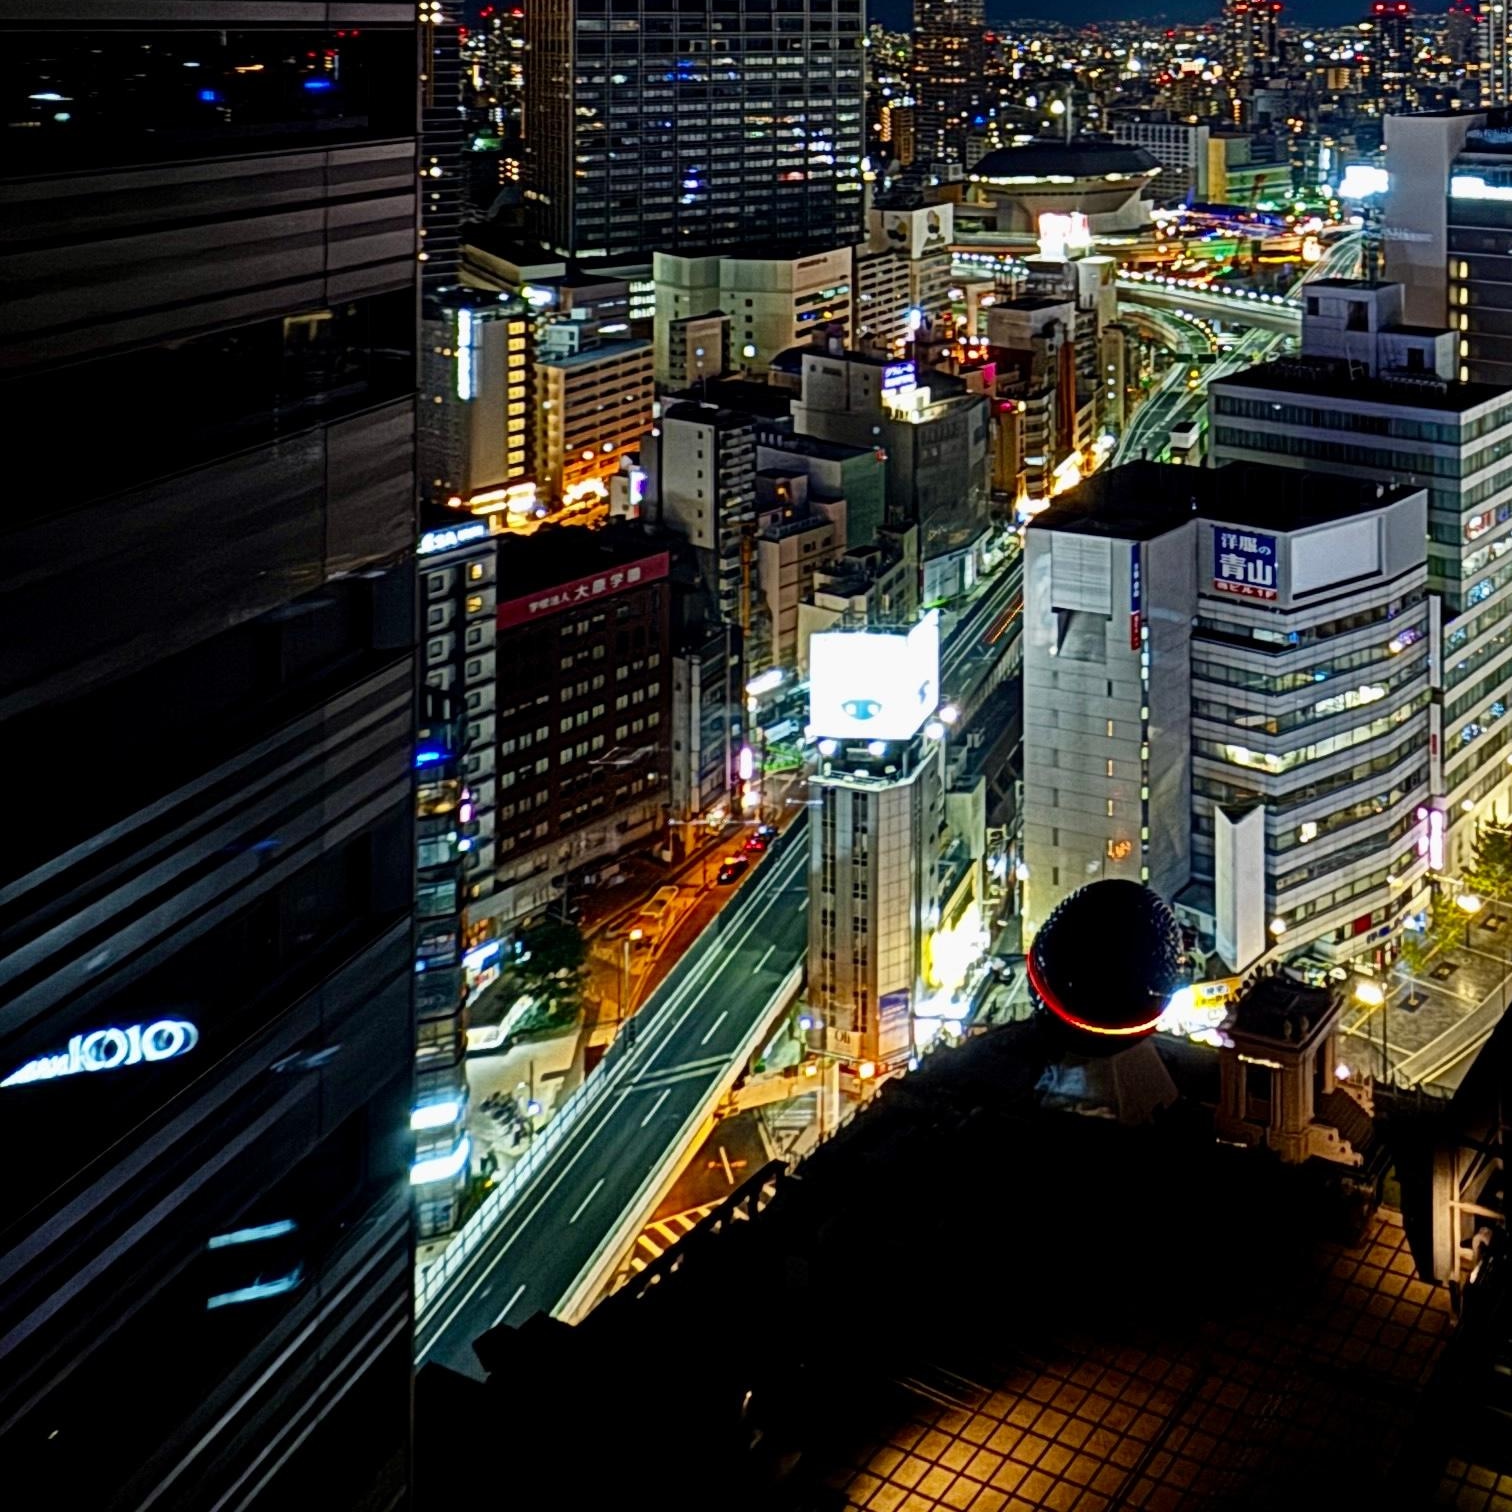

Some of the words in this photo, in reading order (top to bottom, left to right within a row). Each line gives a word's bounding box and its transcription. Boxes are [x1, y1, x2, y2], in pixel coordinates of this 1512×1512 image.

[1220, 532, 1272, 556] 洋服の
[1219, 552, 1273, 586] 青山
